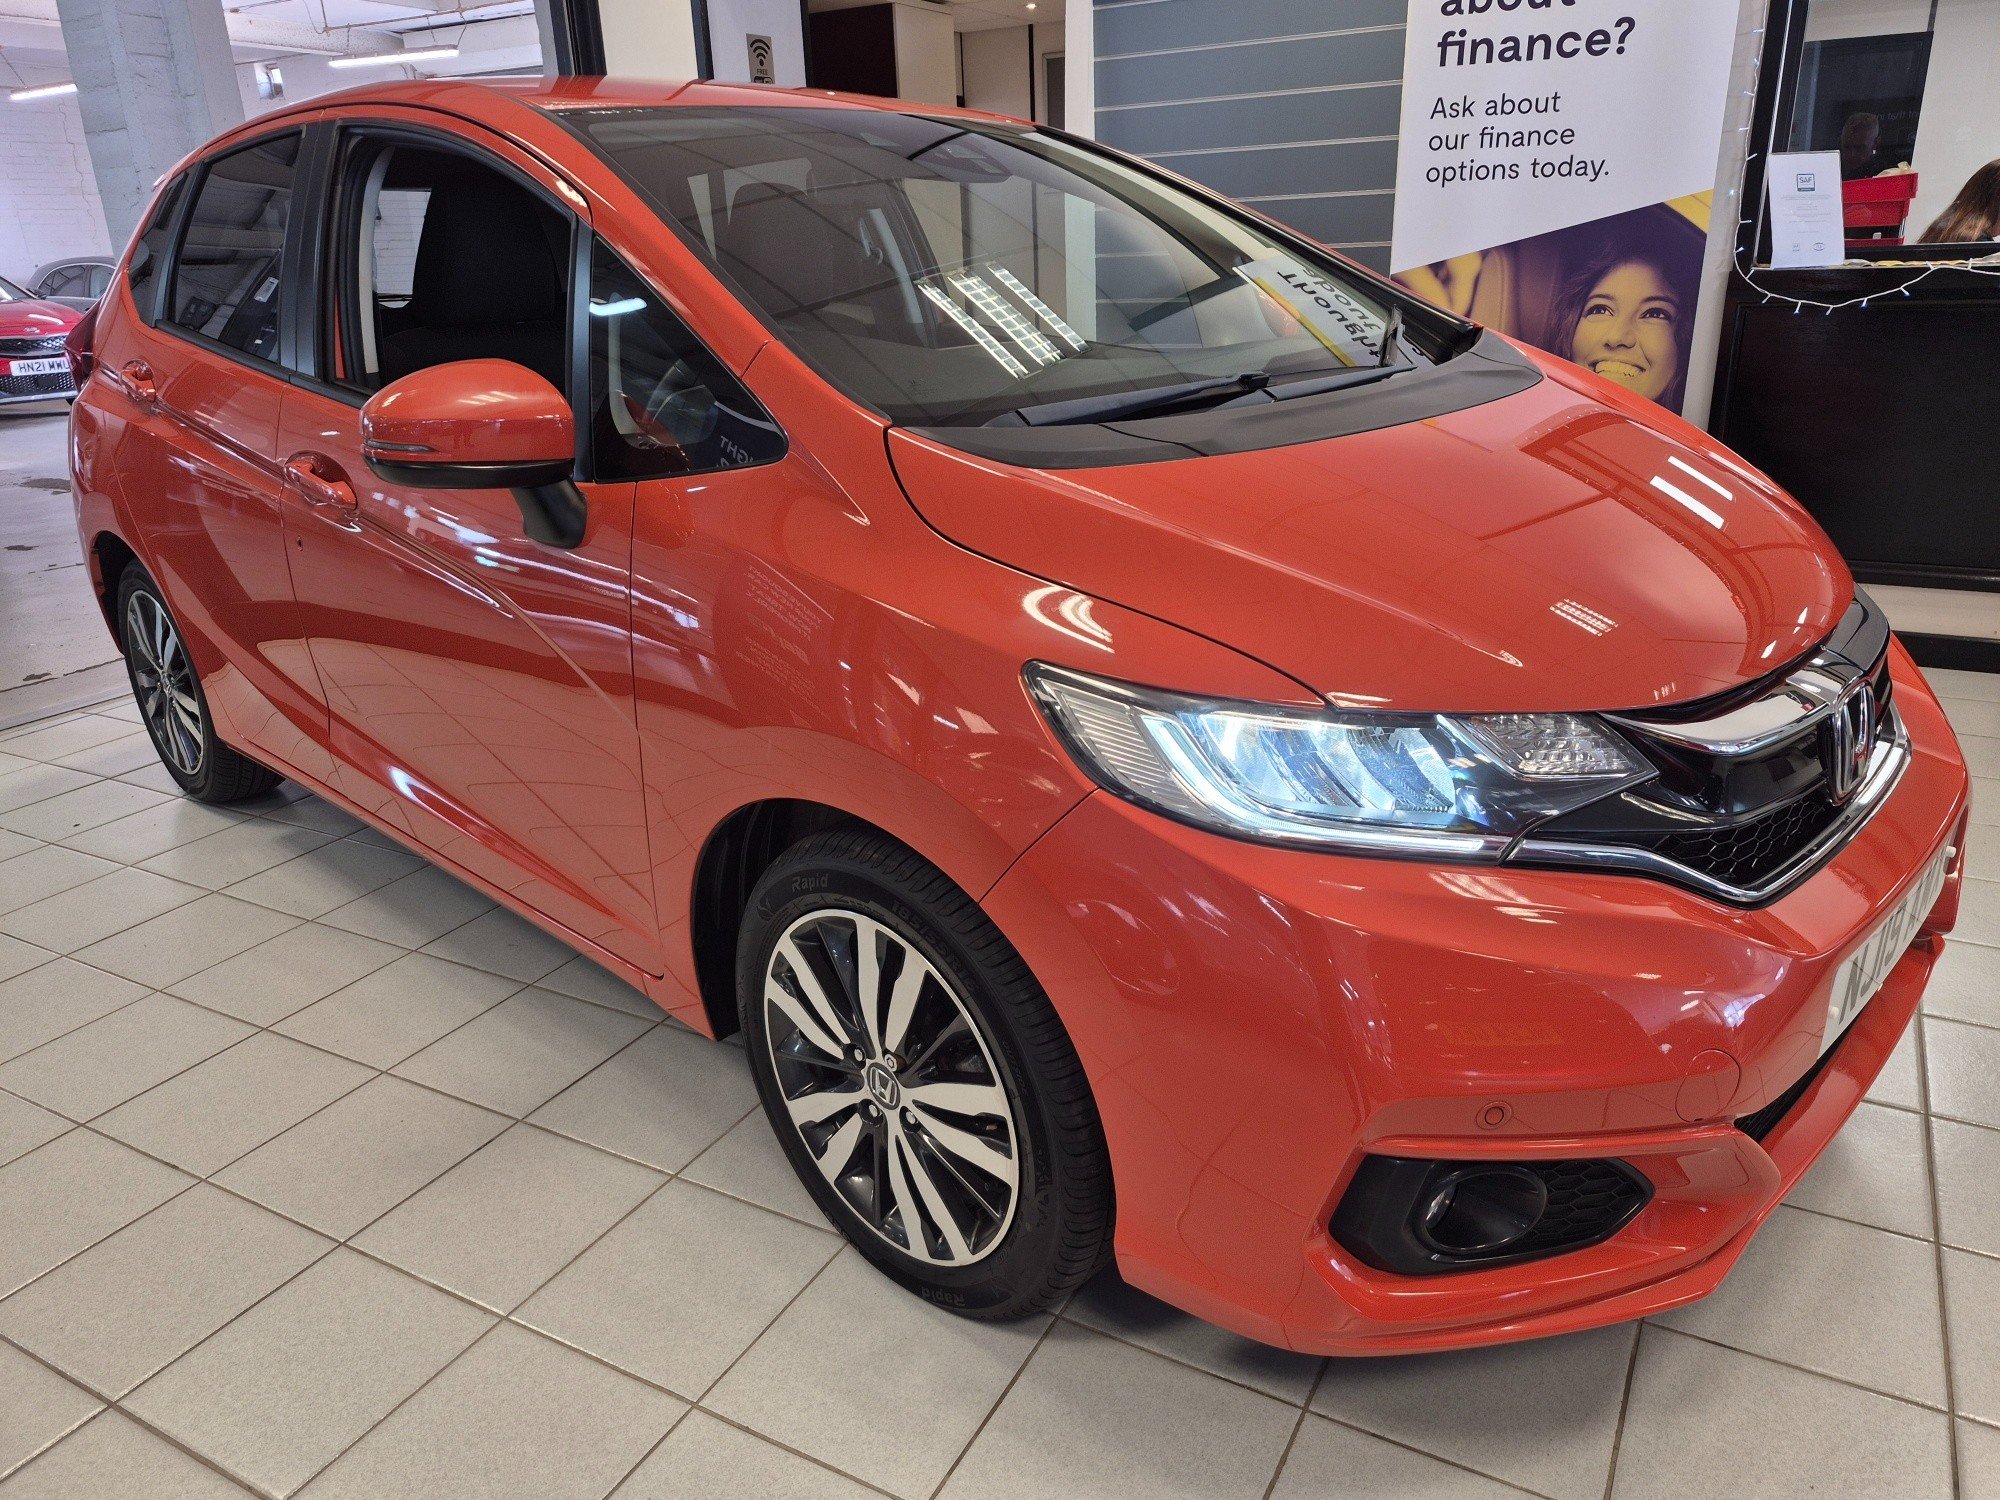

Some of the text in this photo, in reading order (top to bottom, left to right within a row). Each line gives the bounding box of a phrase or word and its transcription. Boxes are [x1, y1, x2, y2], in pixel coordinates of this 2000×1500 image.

[1437, 16, 1636, 67] finance?
[1430, 92, 1561, 119] Ask about
[1429, 126, 1575, 151] our finance
[1426, 155, 1609, 187] options today.
[18, 361, 45, 373] HN21
[791, 872, 829, 892] Rapid
[1838, 895, 1909, 1025] NJ19
[921, 1286, 966, 1307] Rapid
